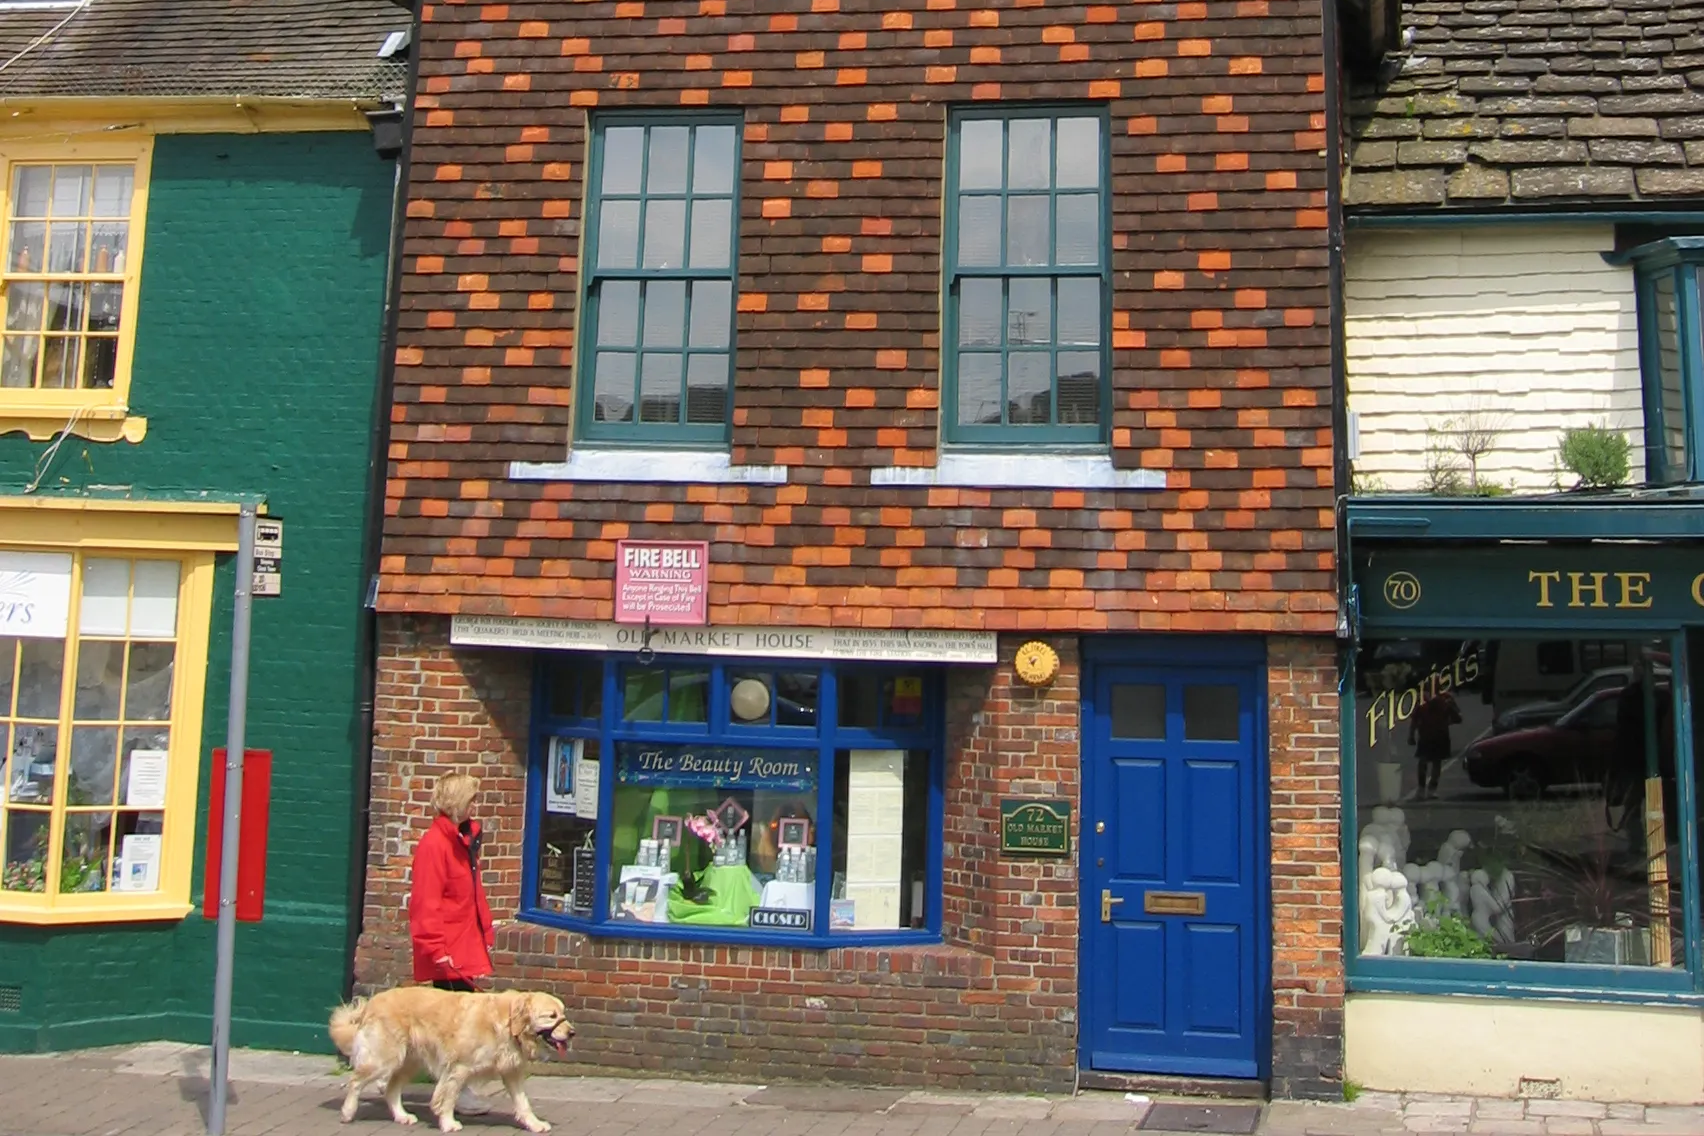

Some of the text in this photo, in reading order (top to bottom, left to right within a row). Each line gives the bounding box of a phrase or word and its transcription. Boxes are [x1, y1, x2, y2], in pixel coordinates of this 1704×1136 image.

[624, 548, 701, 569] FIRE BELL
[630, 570, 691, 580] WARNING
[622, 584, 702, 595] Anyone Ringing This Bell
[1388, 580, 1417, 602] 70
[1528, 570, 1654, 609] THE
[622, 593, 646, 603] Except
[654, 594, 670, 602] Case
[680, 594, 696, 603] Fire
[648, 602, 691, 612] Prosecuted
[663, 630, 745, 647] MARKET
[756, 633, 814, 649] HOUSE
[833, 639, 850, 647] THAT
[880, 640, 896, 648] THIS
[914, 640, 938, 648] KNOWN
[945, 642, 958, 650] THE
[958, 642, 976, 650] TOWN
[977, 642, 992, 650] HALL
[1365, 653, 1480, 748] Florists
[638, 750, 800, 781] The Beauty Room
[1026, 808, 1044, 822] 72
[1008, 823, 1064, 834] OLD MARKET
[1020, 836, 1049, 846] HOUSE
[754, 912, 806, 927] CLOSED
